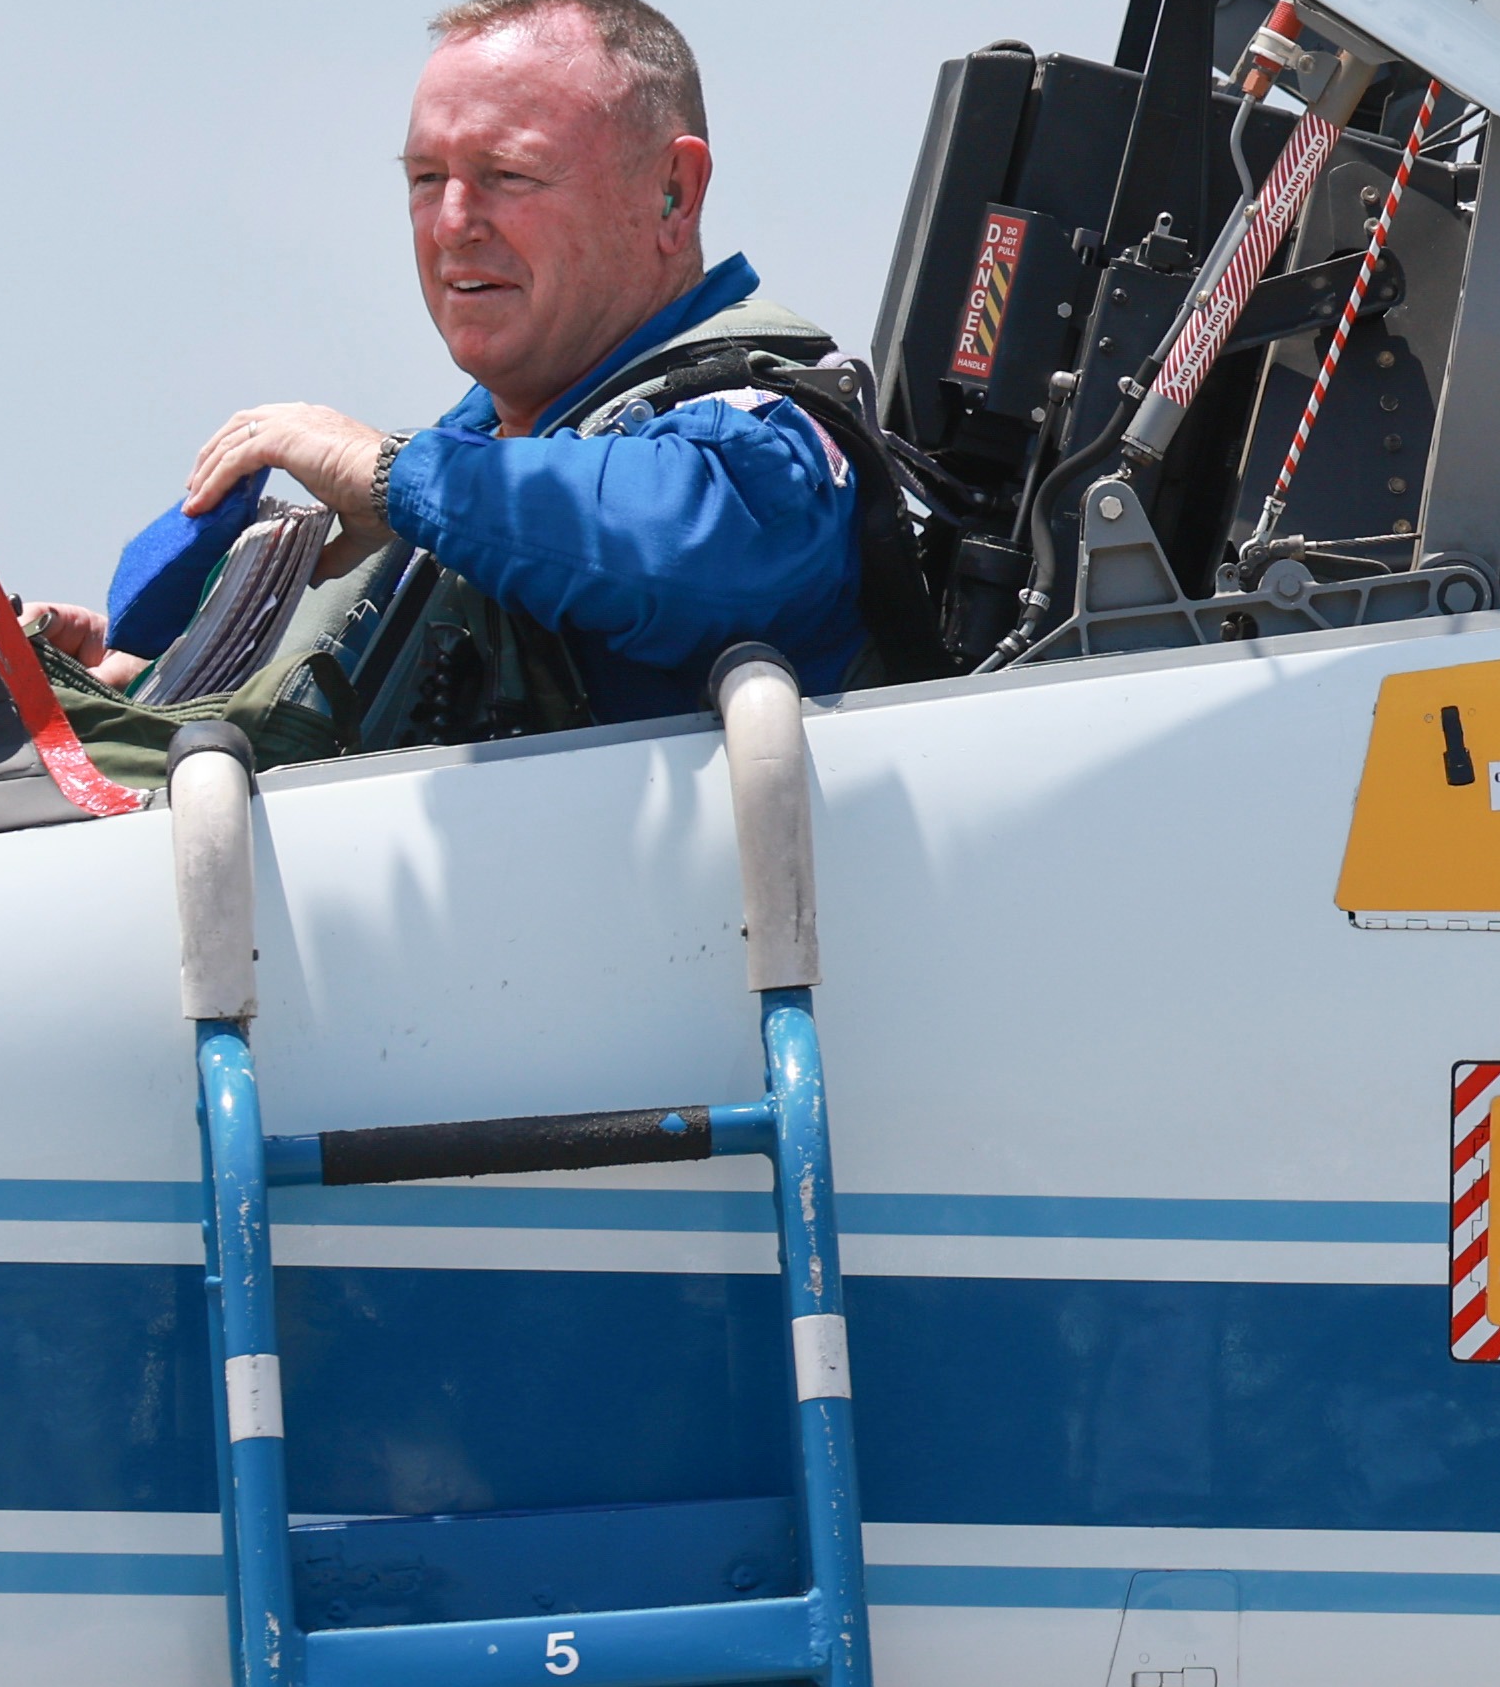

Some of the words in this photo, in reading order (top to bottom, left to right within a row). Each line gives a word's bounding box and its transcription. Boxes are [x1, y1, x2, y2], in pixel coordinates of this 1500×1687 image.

[1270, 205, 1286, 224] NO
[1282, 172, 1305, 203] HAND
[1303, 137, 1325, 169] HOLD
[1002, 236, 1017, 246] NOT
[1006, 226, 1018, 236] DO
[998, 245, 1016, 256] PULL
[959, 223, 1001, 354] DANGER
[1178, 369, 1192, 386] NO
[1188, 337, 1211, 367] HAND
[1208, 300, 1230, 332] HOLD
[958, 358, 986, 371] HANDLE
[544, 1630, 579, 1676] 5
